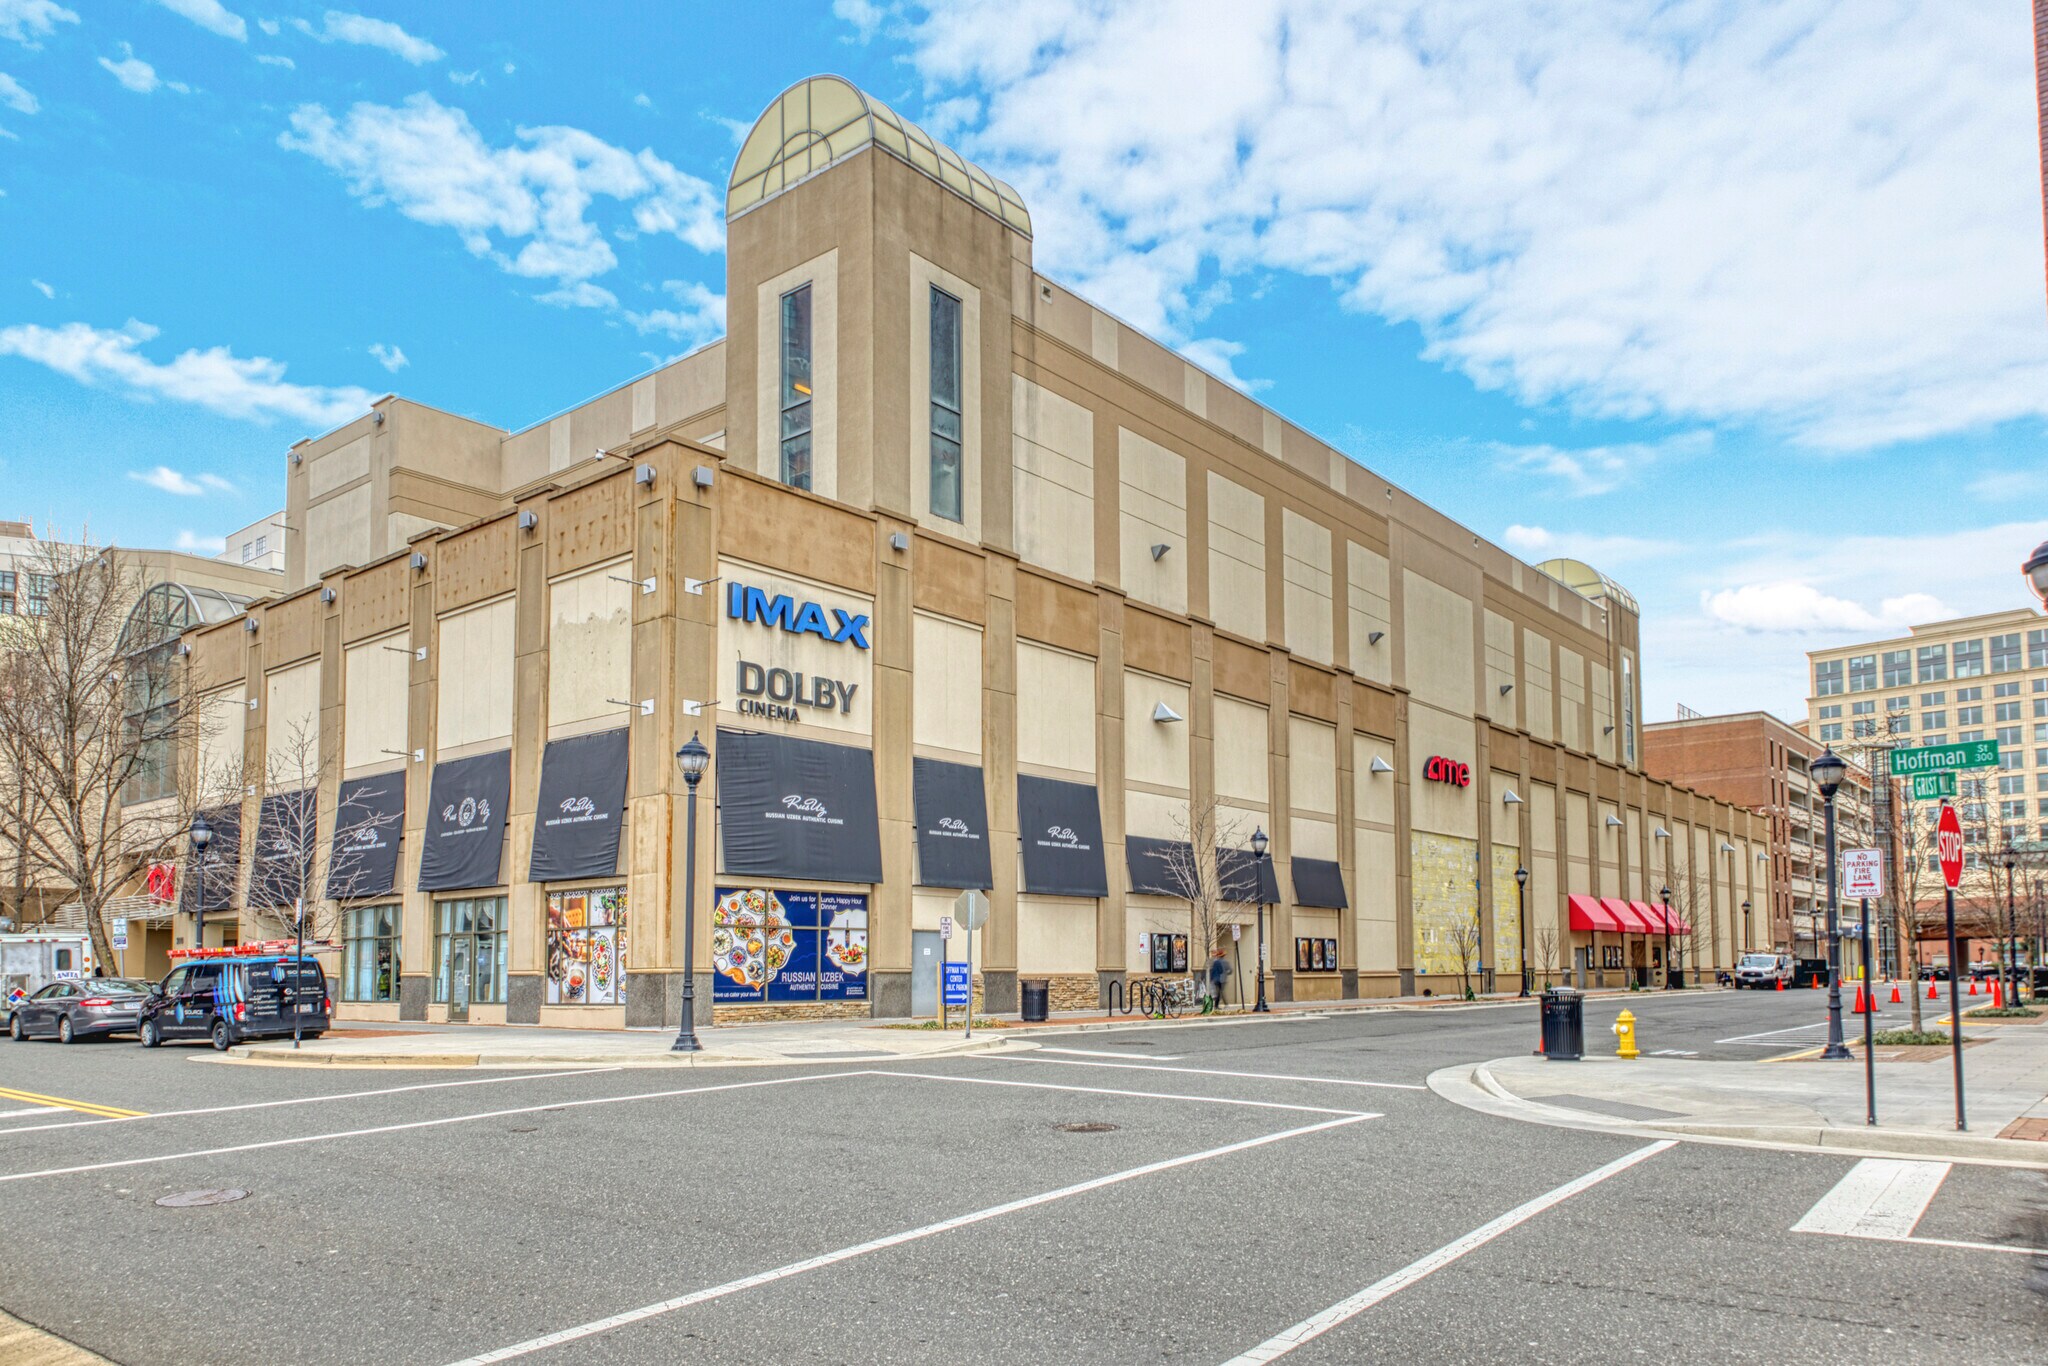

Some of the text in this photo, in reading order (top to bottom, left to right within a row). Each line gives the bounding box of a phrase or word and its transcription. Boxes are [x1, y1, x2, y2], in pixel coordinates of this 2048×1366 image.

[727, 582, 870, 649] IMAX
[736, 660, 858, 714] DOLBY
[736, 698, 800, 722] CINEMA
[1896, 744, 1988, 770] Hoffman St
[1975, 752, 1993, 762] 300
[1423, 755, 1470, 788] amc
[1915, 776, 1938, 796] GRIST
[802, 815, 826, 824] AUTHENTIC
[1940, 830, 1961, 862] STOP
[836, 897, 850, 905] Happy
[56, 971, 79, 979] ANITA
[781, 971, 844, 982] RUSSIAN UZBEK
[790, 982, 839, 991] AUTHENTIC CUISINE
